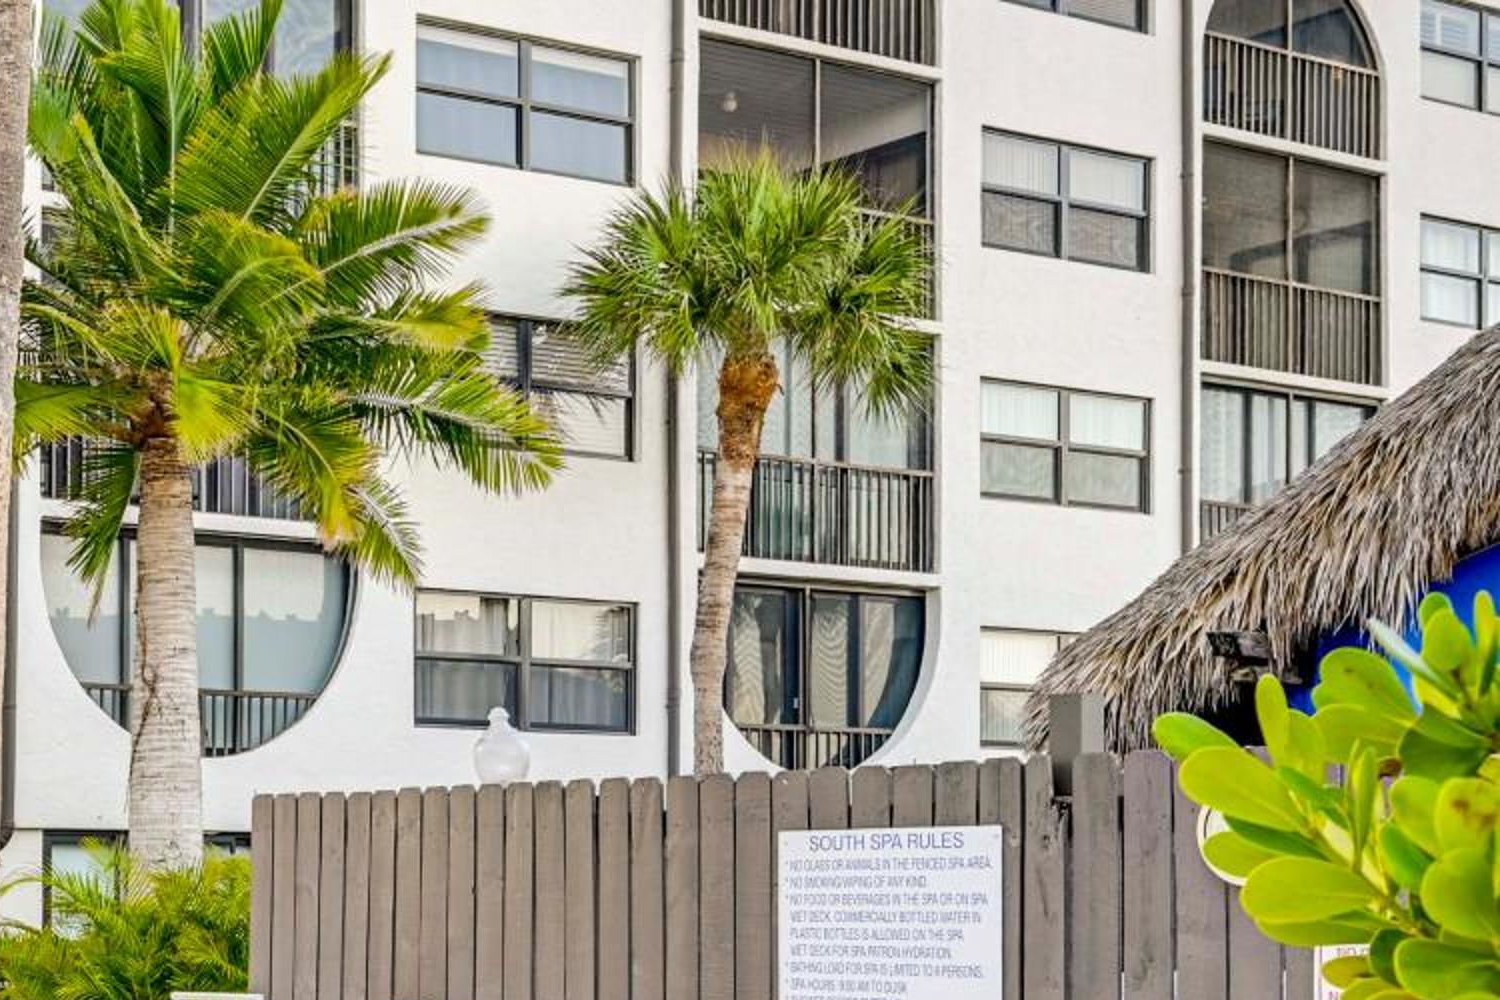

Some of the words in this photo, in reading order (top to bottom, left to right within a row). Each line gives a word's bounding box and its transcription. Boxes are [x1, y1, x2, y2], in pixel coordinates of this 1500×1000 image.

[809, 834, 864, 852] SOUTH
[870, 833, 902, 851] SPA
[907, 831, 964, 850] RULES
